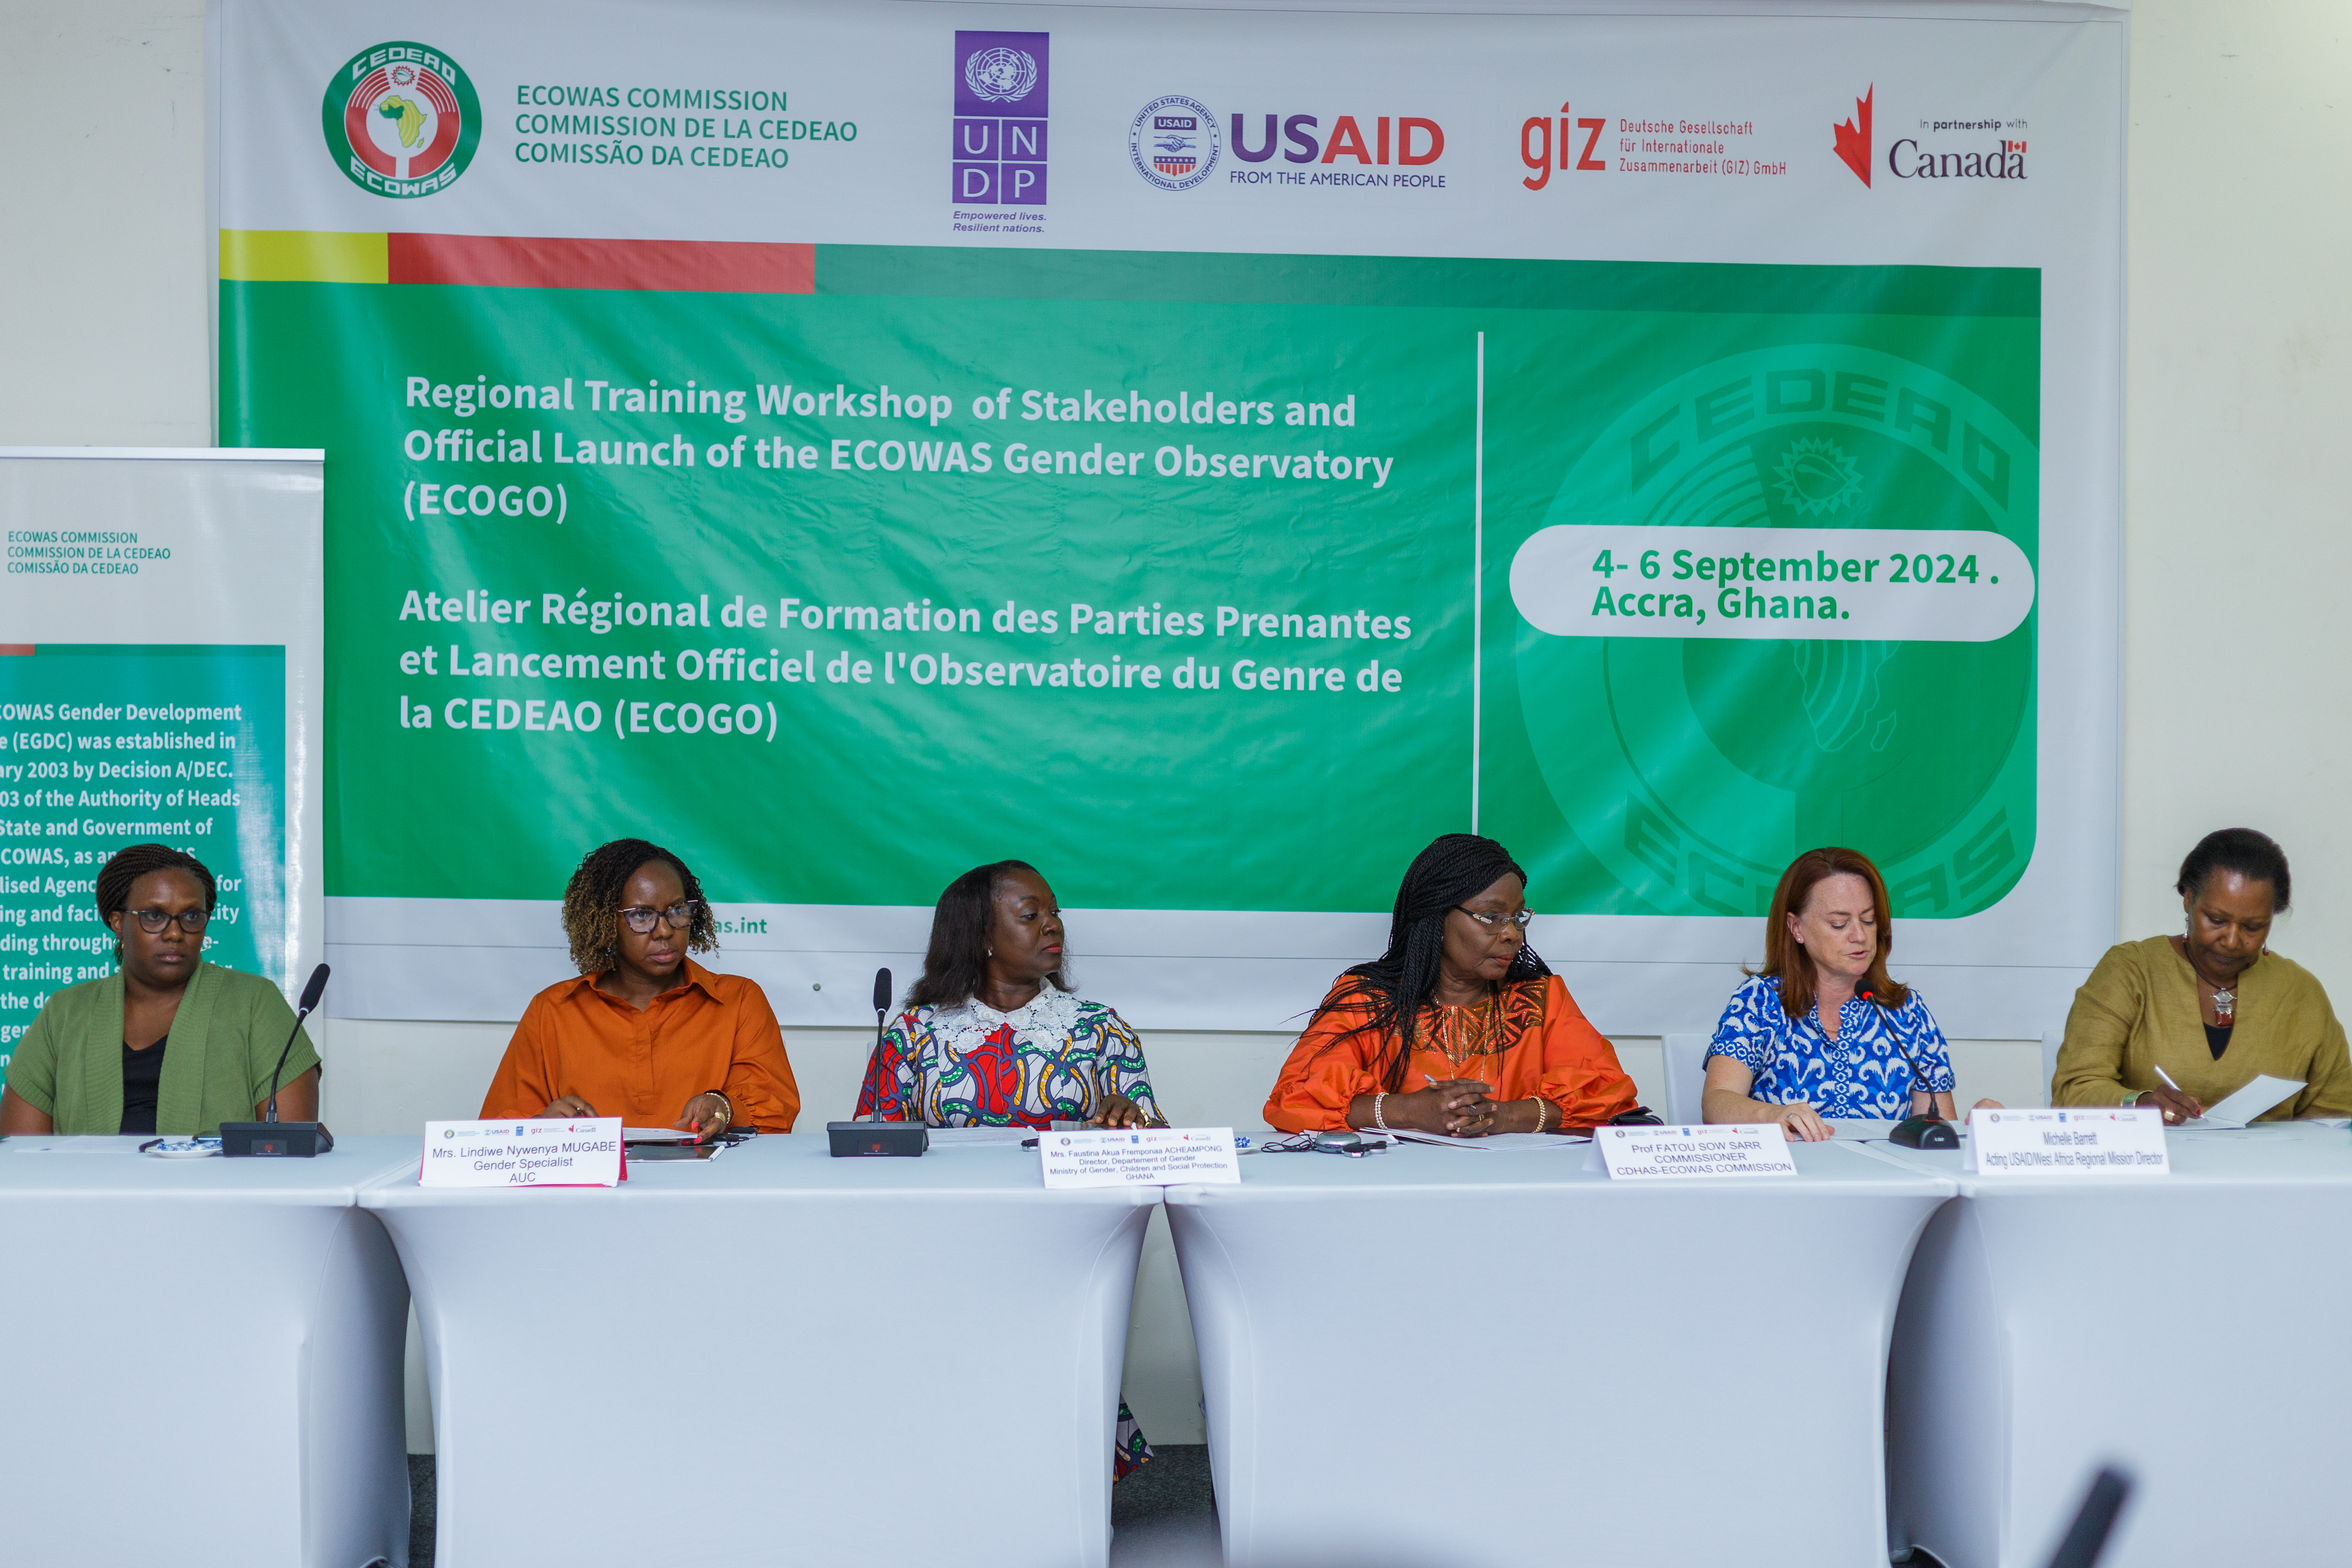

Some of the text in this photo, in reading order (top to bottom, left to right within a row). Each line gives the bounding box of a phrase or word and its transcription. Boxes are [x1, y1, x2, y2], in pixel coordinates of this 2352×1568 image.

[352, 47, 455, 86] CEDEAO
[518, 86, 786, 111] ECOWAS COMMISSION
[1135, 102, 1158, 126] UNITED
[1190, 102, 1216, 129] AGENCY
[1158, 119, 1192, 127] USAID
[516, 114, 857, 141] COMMISSION DE LA CEDEAO
[1620, 119, 1752, 135] Deutsche Gesellschaft
[1920, 119, 2027, 132] In partnership with
[1231, 113, 1444, 165] USAID
[1522, 102, 1605, 190] giz
[1620, 138, 1724, 154] für Internationale
[515, 140, 788, 168] COMISSÃO DA CEDEAO
[1890, 139, 2027, 179] Canada
[1131, 143, 1219, 188] INTERNATIONAL DEVELOPMENT
[1620, 158, 1785, 176] Zusammenarbeit (GIZ) GmbH
[351, 156, 456, 195] ECOWAS
[1231, 171, 1445, 187] FROM THE AMERICAN PEOPLE
[953, 211, 1046, 220] Empowered lives.
[953, 223, 1000, 231] Resilient
[407, 375, 1354, 426] Regional Training Workshop of Stakeholders and
[404, 429, 1393, 488] Official Launch of the ECOWAS Gender Observatory
[404, 481, 567, 524] (ECOGO)
[9, 531, 137, 543] ECOWAS COMMISSION
[8, 547, 170, 559] COMMISSION DE LA CEDEAO
[8, 560, 138, 574] COMISSÃO DA CEDEAO
[1640, 550, 1660, 579] 6
[1672, 550, 1880, 588] September
[1890, 554, 1979, 583] 2024
[399, 588, 1411, 639] Atelier Régional de Formation des Parties Prenantes
[1592, 587, 1849, 625] Accra, Ghana.
[400, 645, 1402, 692] et Lancement Officiel de l'Observatoire du Genre de
[59, 703, 242, 724] Gender Development
[401, 695, 777, 742] la CEDEAO (ECOGO)
[13, 732, 235, 752] (EGDC) was established in
[28, 760, 233, 782] 2003 by Decision A/DEC.
[24, 789, 240, 810] of the Authority of Heads
[46, 818, 77, 835] and
[83, 819, 190, 835] Government
[196, 818, 213, 834] of
[216, 874, 241, 892] for
[31, 905, 62, 922] and
[77, 962, 109, 979] and
[1632, 1145, 1653, 1153] Prof
[1656, 1144, 1695, 1152] FATOU
[1699, 1142, 1725, 1151] SOW
[2043, 1132, 2098, 1145] Michelle Barrett
[433, 1142, 616, 1158] Mrs. Lindiwe Nywenya MUGABE
[1655, 1153, 1747, 1163] COMMISSIONER
[474, 1157, 573, 1170] Gender Specialist
[1112, 1156, 1158, 1166] Departement
[1617, 1163, 1792, 1175] CDHAS-ECOWAS COMMISSION
[1986, 1151, 2163, 1169] Acting USAID/West Africa Regional Mission Director
[510, 1172, 535, 1182] AUC
